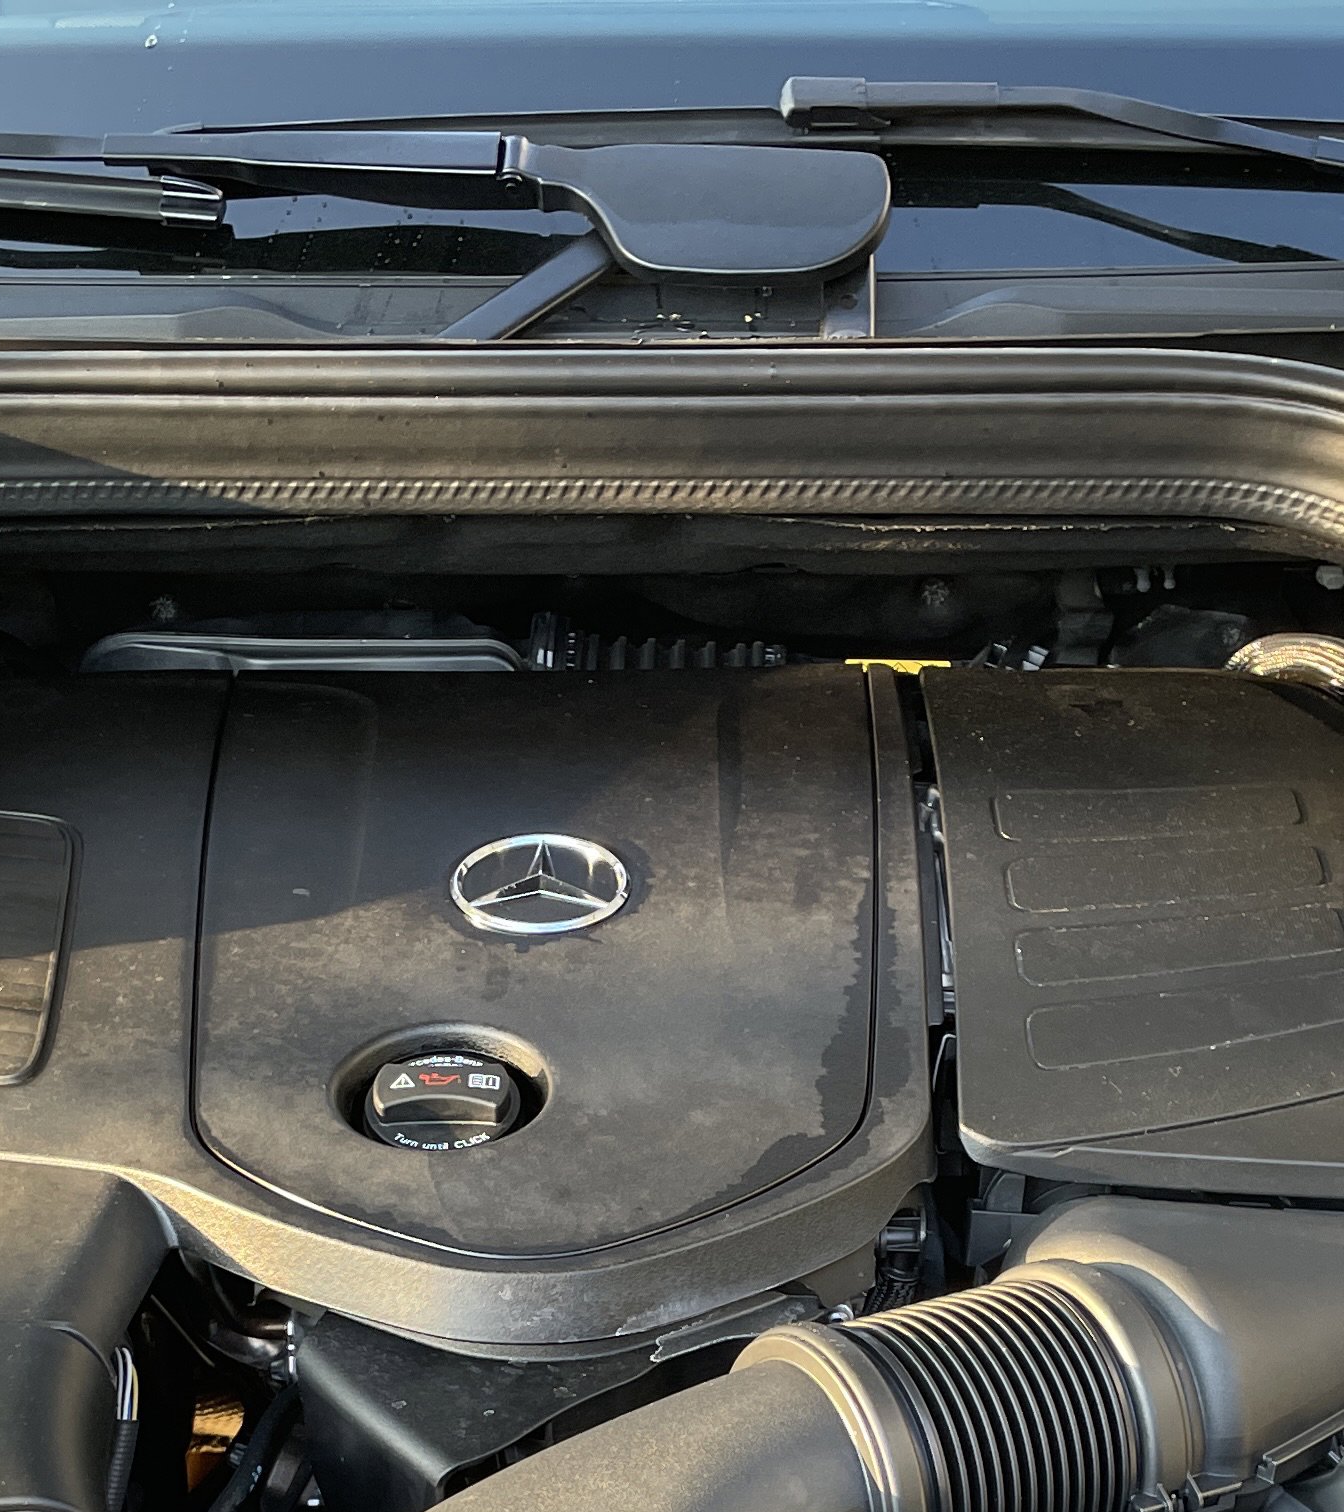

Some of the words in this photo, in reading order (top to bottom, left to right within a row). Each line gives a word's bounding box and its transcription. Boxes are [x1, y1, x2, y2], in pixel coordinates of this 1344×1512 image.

[394, 1132, 418, 1148] Turn
[422, 1140, 449, 1150] until
[453, 1132, 490, 1149] CLICK
